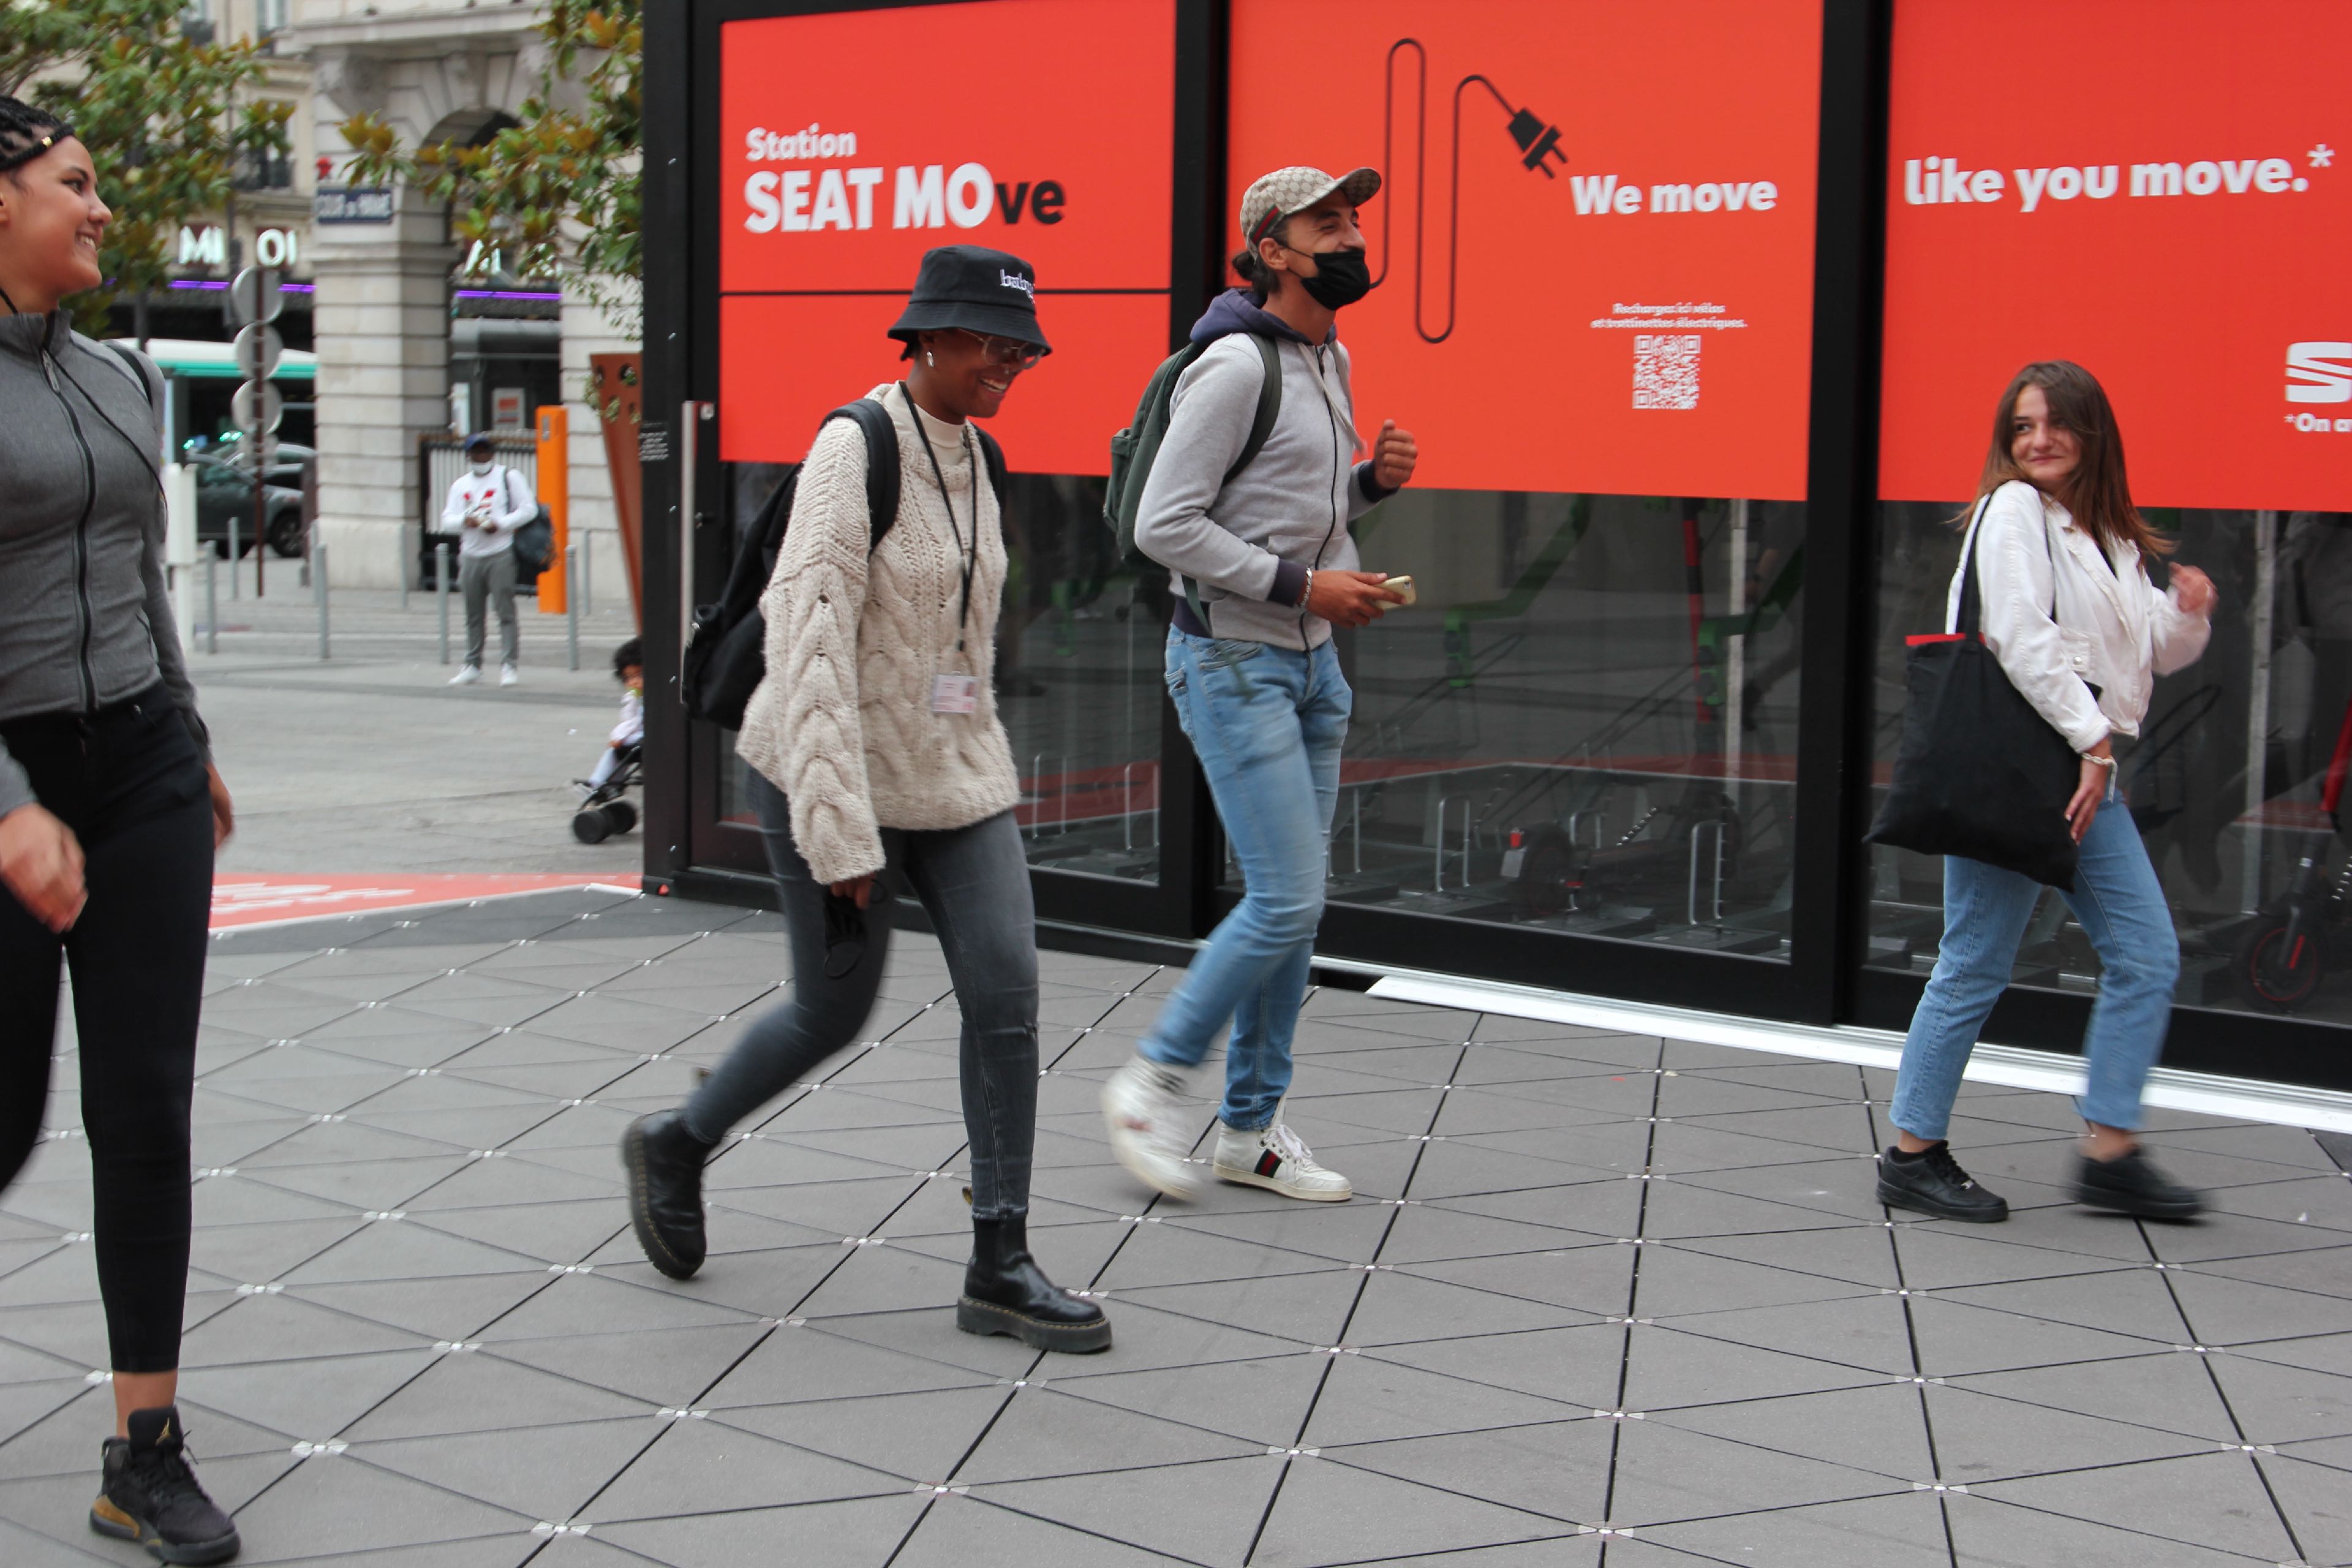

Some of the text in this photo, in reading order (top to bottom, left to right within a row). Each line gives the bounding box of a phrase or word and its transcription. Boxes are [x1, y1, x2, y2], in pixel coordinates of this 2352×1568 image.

[745, 123, 857, 162] Station
[744, 167, 884, 233] SEAT
[1570, 174, 1778, 215] We move
[1905, 156, 2005, 205] like
[2013, 165, 2119, 213] you
